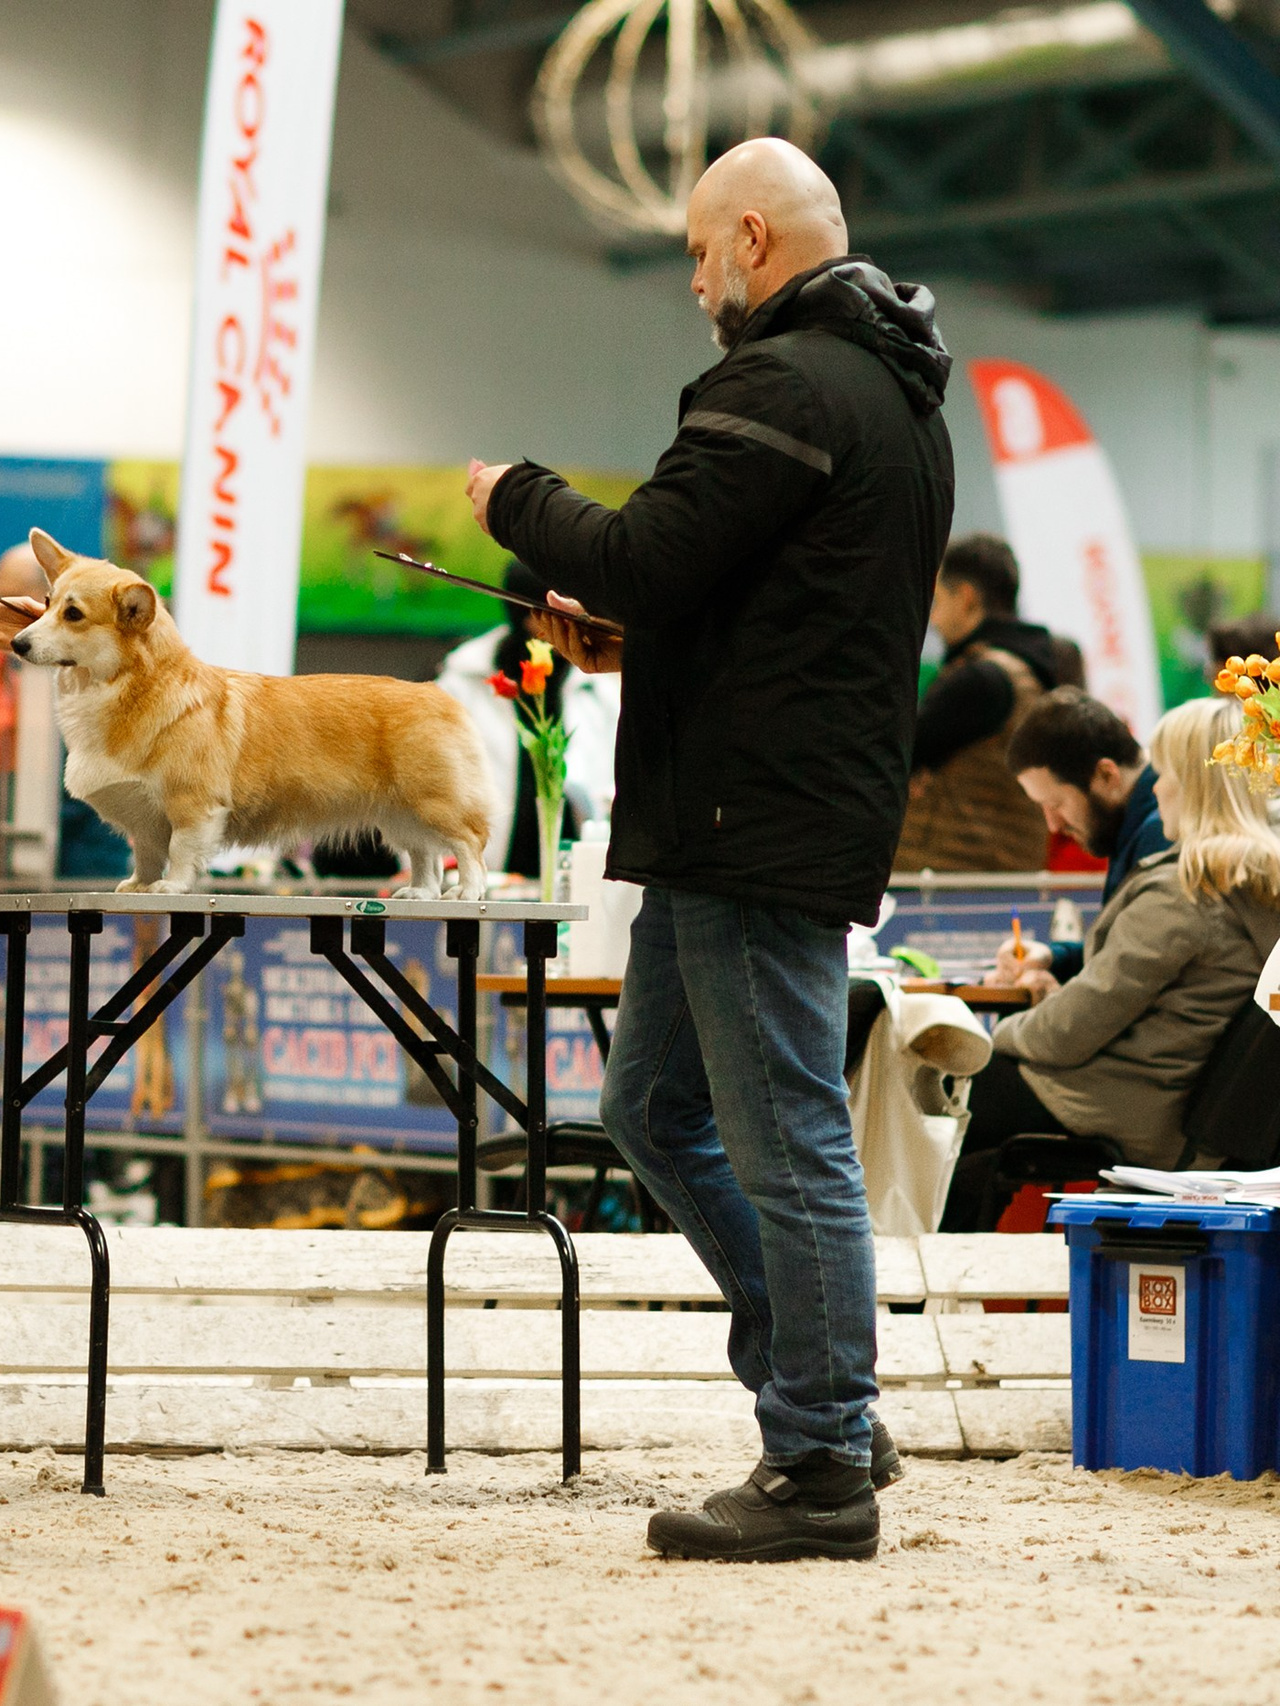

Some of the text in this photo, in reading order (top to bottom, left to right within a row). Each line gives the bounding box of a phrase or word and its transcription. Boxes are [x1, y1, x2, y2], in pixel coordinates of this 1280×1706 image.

[207, 17, 266, 597] ROYAL CANIN
[1143, 1281, 1173, 1295] ROX
[1143, 1295, 1173, 1310] BOX
